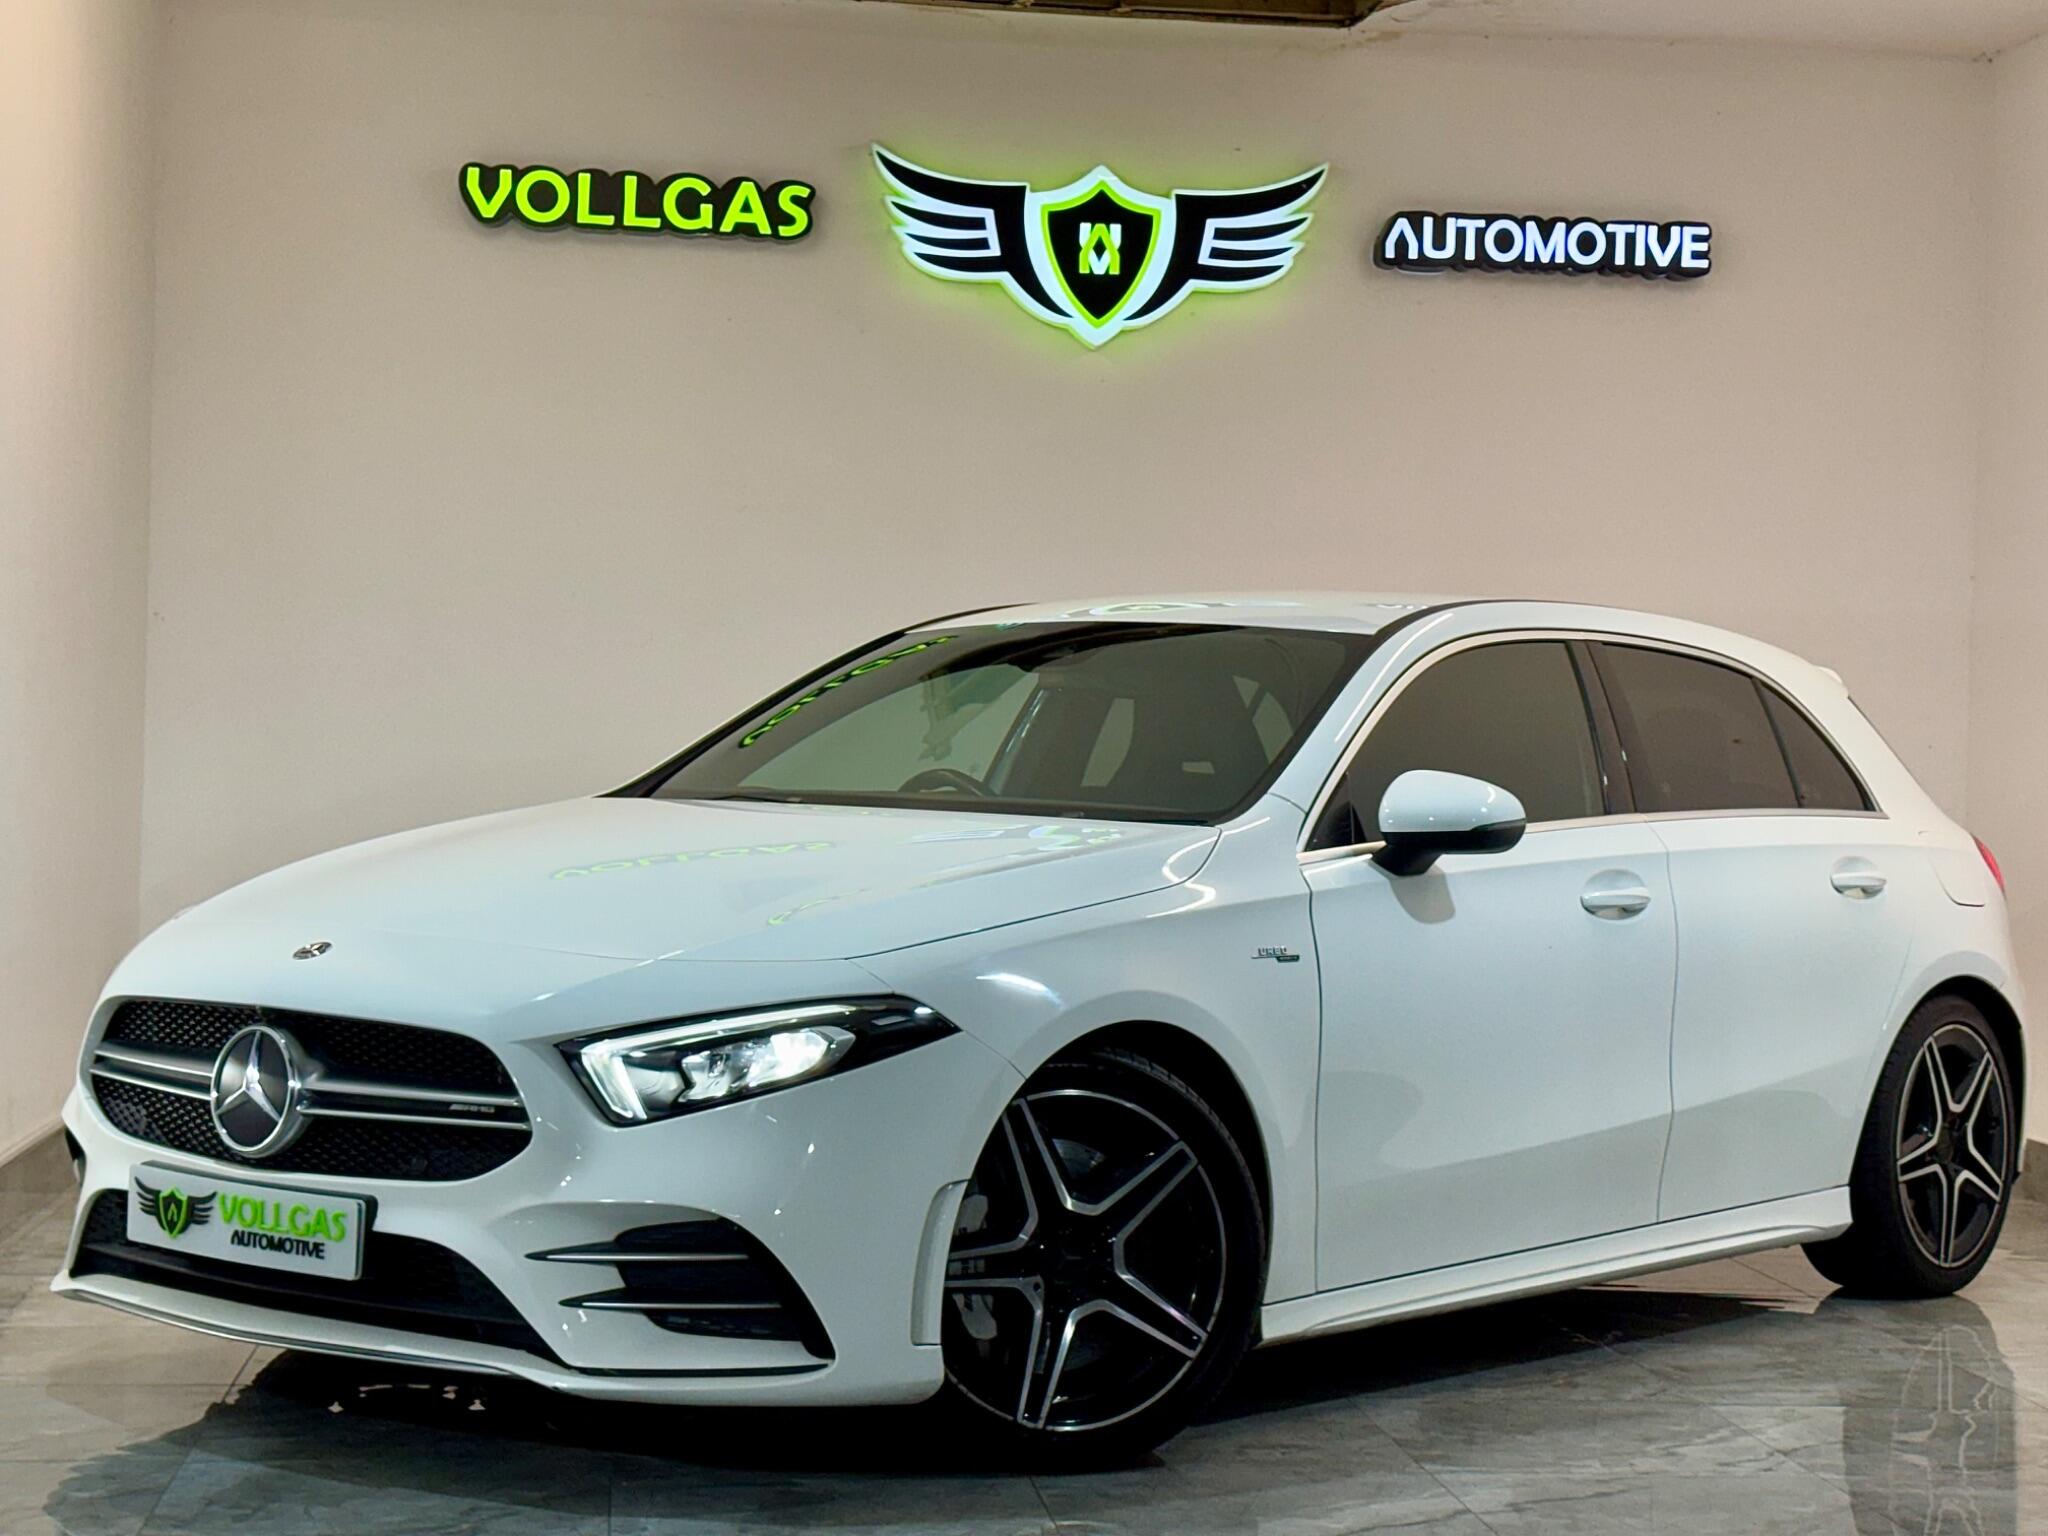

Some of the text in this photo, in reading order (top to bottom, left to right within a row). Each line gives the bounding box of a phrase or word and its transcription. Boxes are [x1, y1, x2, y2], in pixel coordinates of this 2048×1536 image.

[466, 166, 812, 237] VOLLGAS
[1385, 216, 1710, 269] AUTOMOTIVE
[217, 1193, 348, 1243] VOLLGAS
[230, 1229, 326, 1260] AUTOMOTIVE
